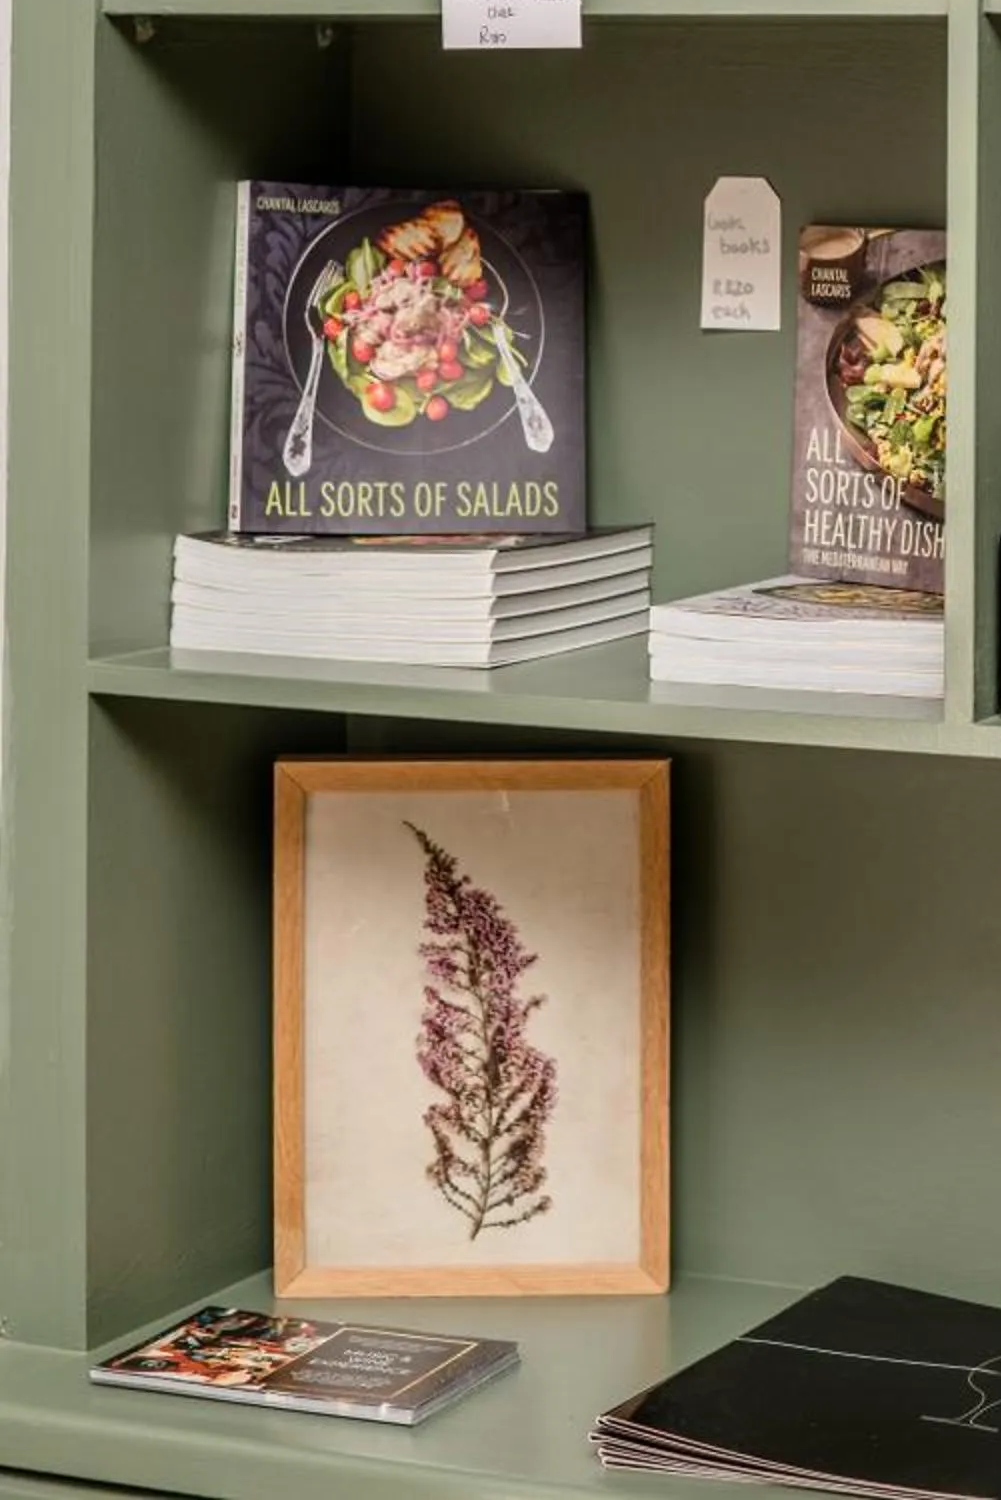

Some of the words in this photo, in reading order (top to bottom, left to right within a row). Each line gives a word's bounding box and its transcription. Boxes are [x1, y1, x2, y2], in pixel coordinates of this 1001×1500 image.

[806, 427, 846, 463] ALL
[265, 480, 313, 517] ALL
[319, 480, 406, 518] SORTS
[413, 481, 449, 518] OF
[455, 481, 560, 518] SALADS
[805, 467, 876, 508] SORTS
[881, 475, 909, 511] OF
[804, 509, 898, 553] HEALTHY
